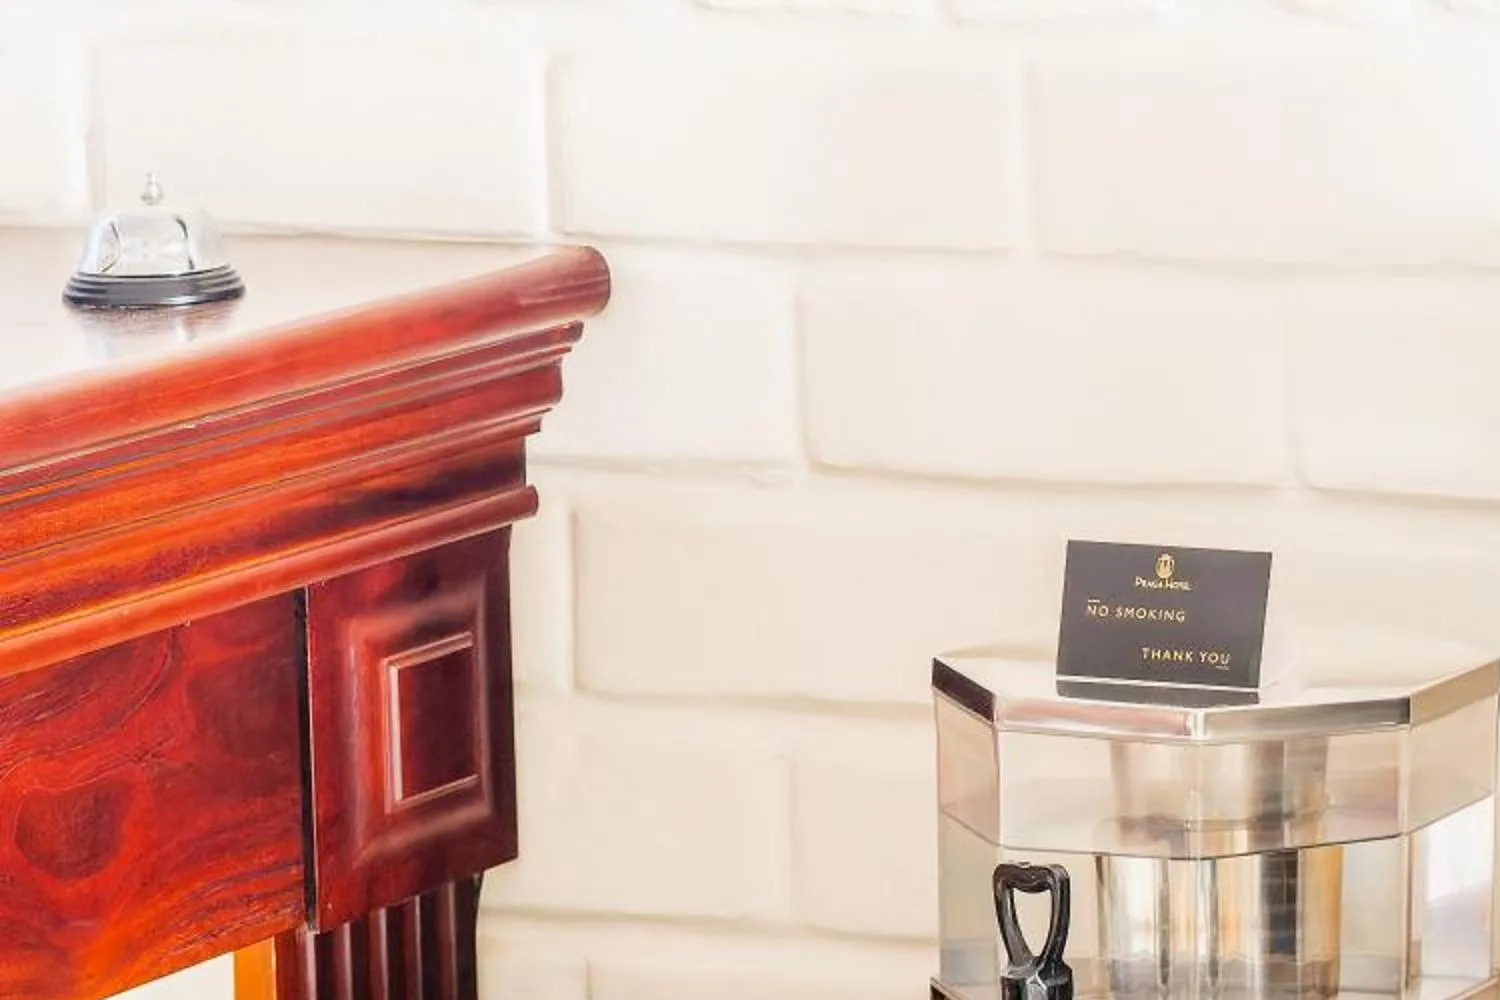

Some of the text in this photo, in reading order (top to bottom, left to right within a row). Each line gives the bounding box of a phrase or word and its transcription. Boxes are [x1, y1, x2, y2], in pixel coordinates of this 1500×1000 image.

[1087, 605, 1186, 623] NO SMOKING
[1141, 647, 1232, 665] THANK YOU
